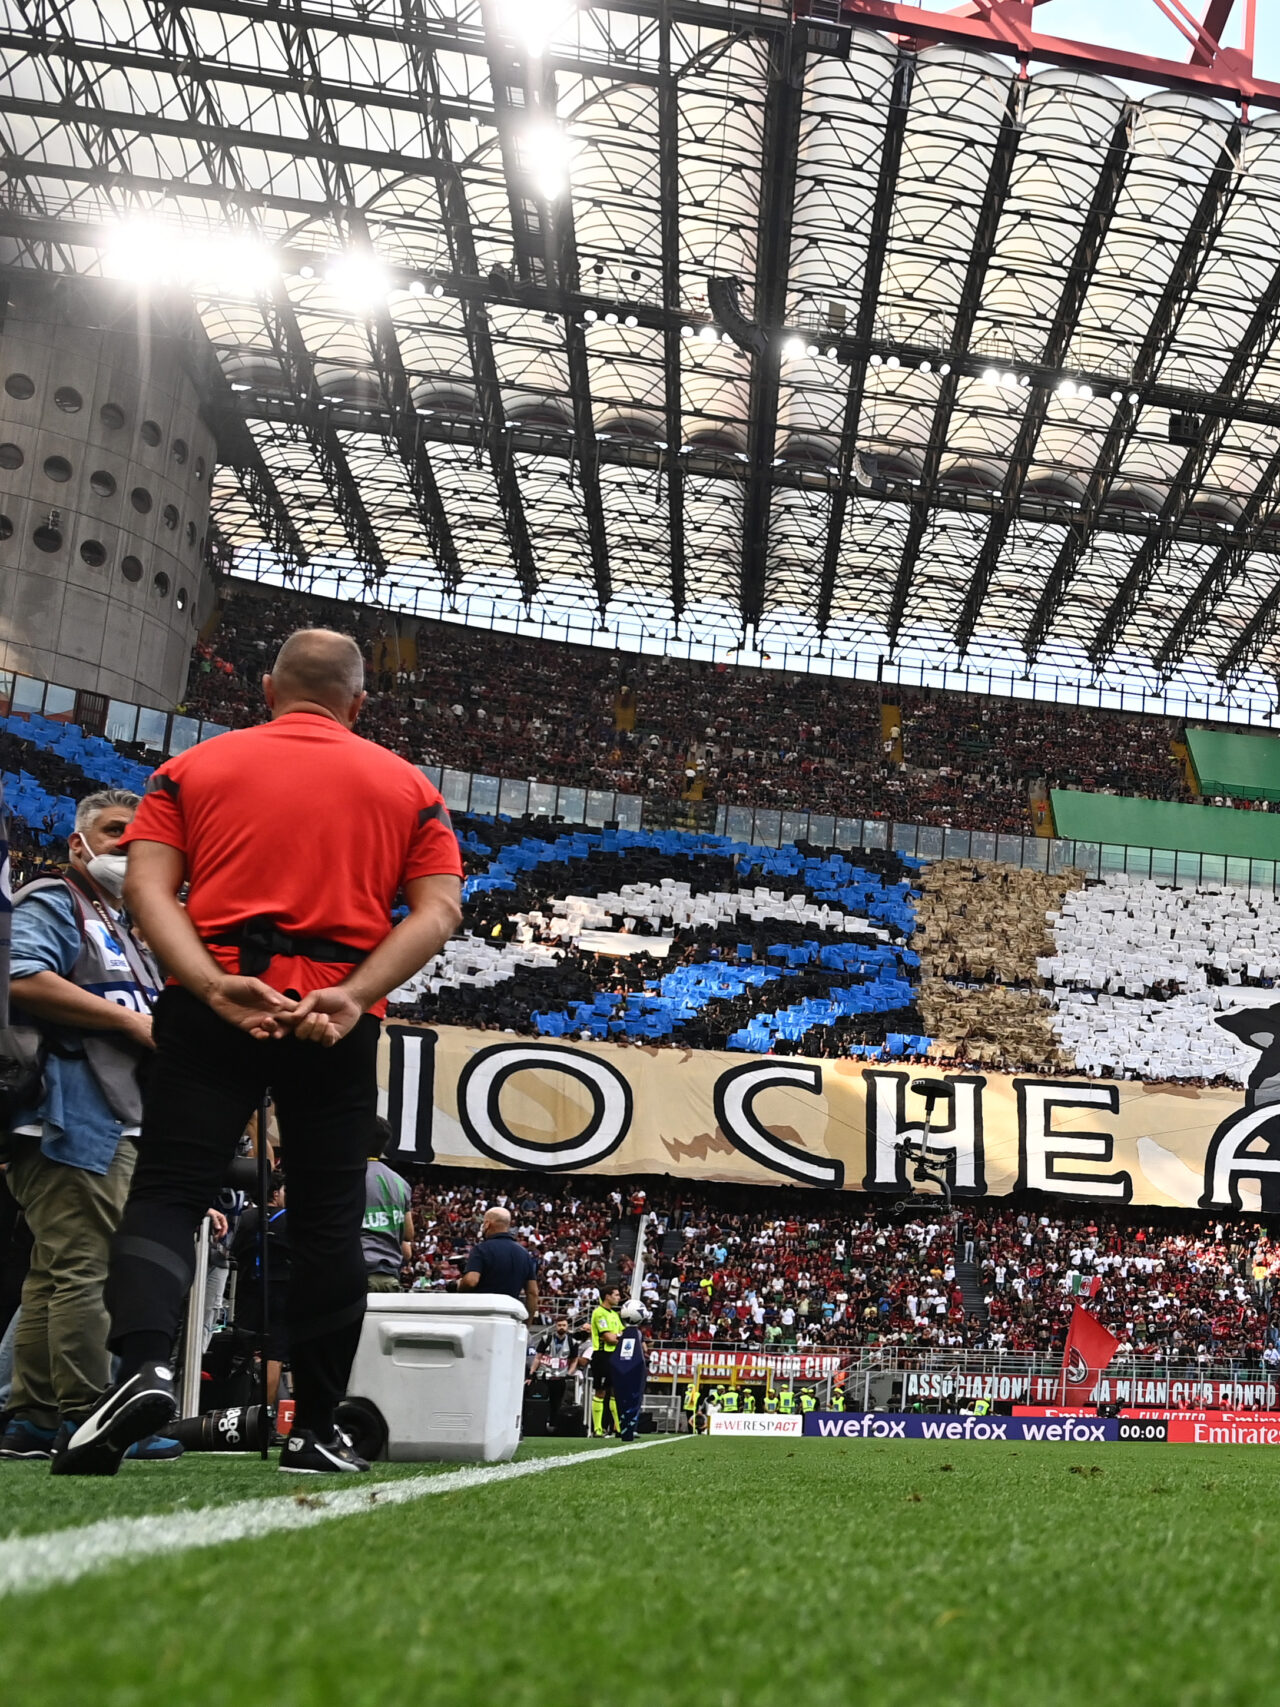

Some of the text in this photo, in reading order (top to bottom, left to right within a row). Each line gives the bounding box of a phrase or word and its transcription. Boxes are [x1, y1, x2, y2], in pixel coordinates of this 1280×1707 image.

[386, 1025, 633, 1171] IO
[714, 1060, 1132, 1204] CHE
[361, 1210, 390, 1228] LUB
[649, 1351, 686, 1374] CASA
[692, 1352, 736, 1376] MILAN
[751, 1354, 800, 1378] JUNIOR
[805, 1356, 841, 1379] CLUB
[1116, 1380, 1167, 1404] MILAN
[1172, 1381, 1213, 1405] CLUB
[1219, 1383, 1277, 1407] MONDO
[714, 1419, 799, 1432] #WERESPACT
[818, 1413, 906, 1439] wefox
[921, 1416, 1007, 1441] wefox
[1022, 1418, 1106, 1442] wefox
[1119, 1424, 1166, 1439] 00:00
